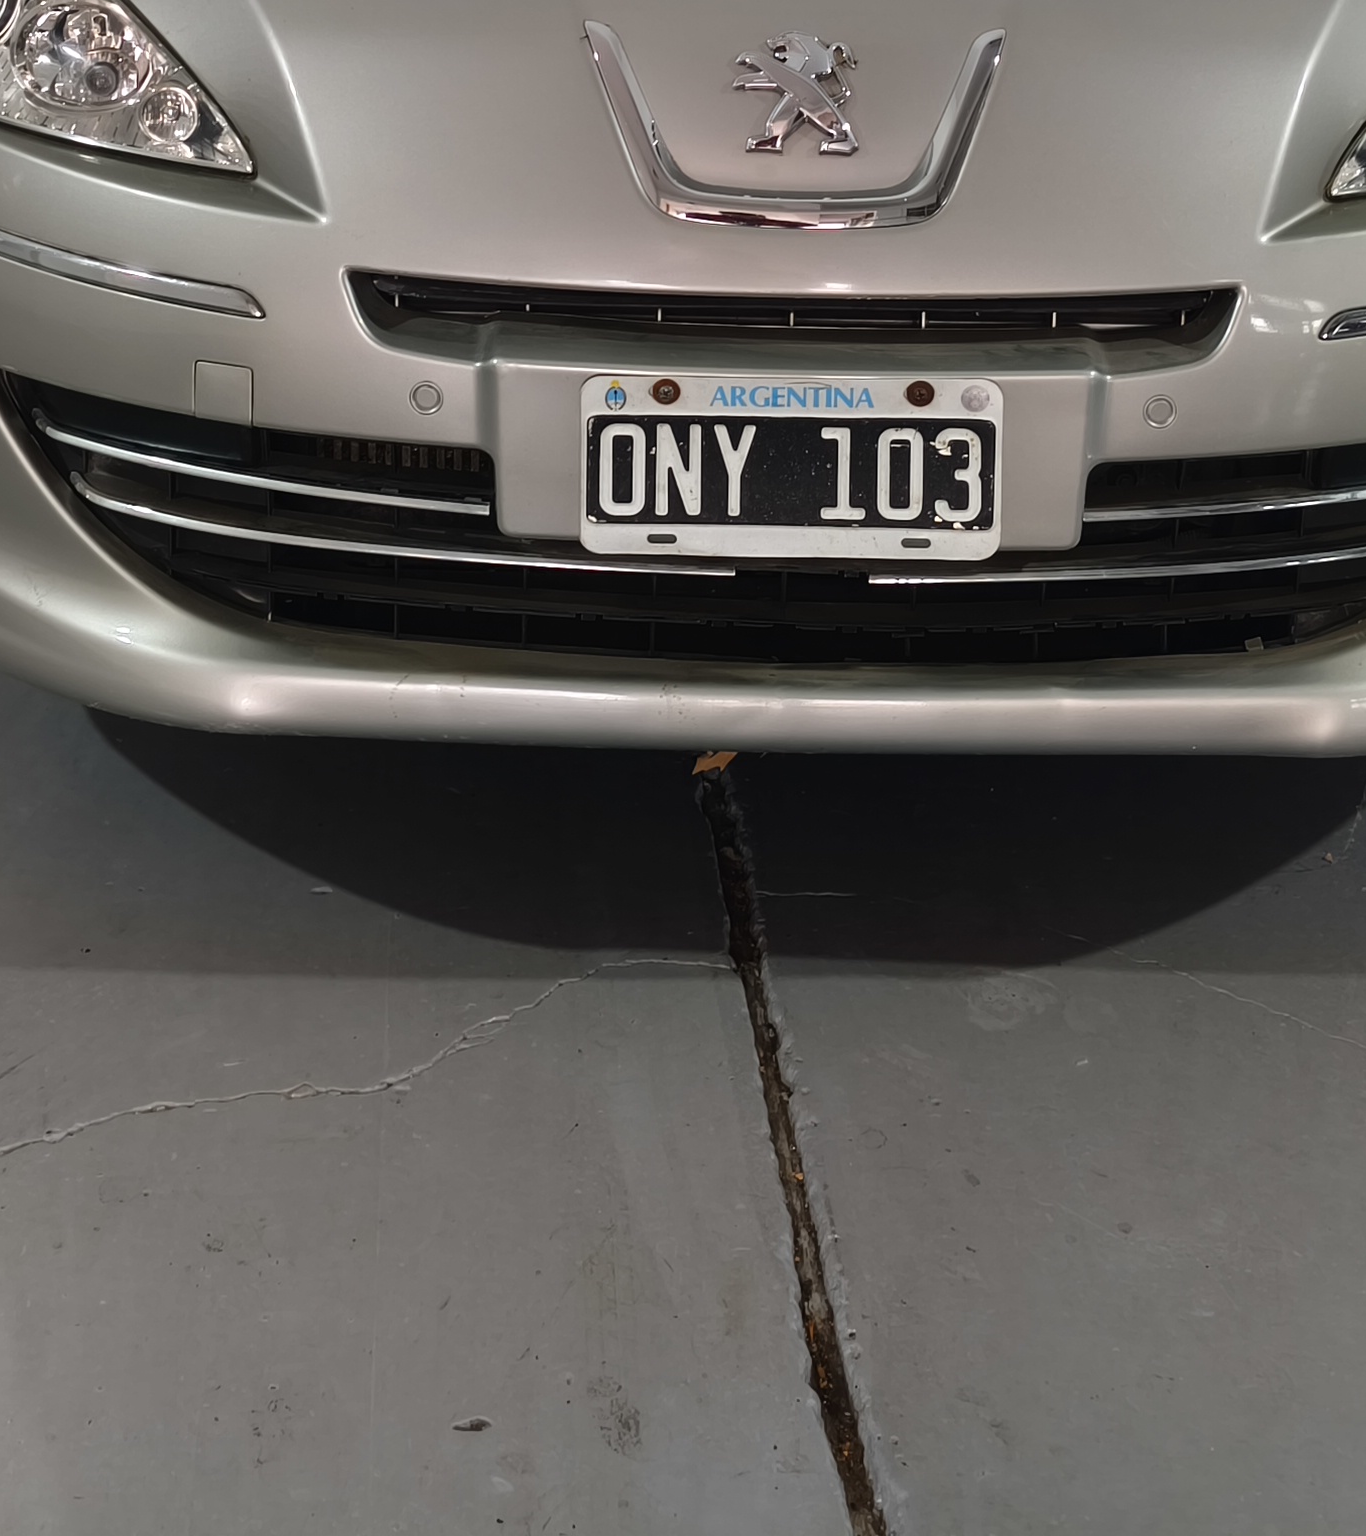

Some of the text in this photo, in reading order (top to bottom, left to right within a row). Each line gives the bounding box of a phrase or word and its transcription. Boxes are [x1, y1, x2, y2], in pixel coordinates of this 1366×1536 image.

[709, 385, 875, 409] ARGENTINA
[598, 422, 982, 523] ONY 103
